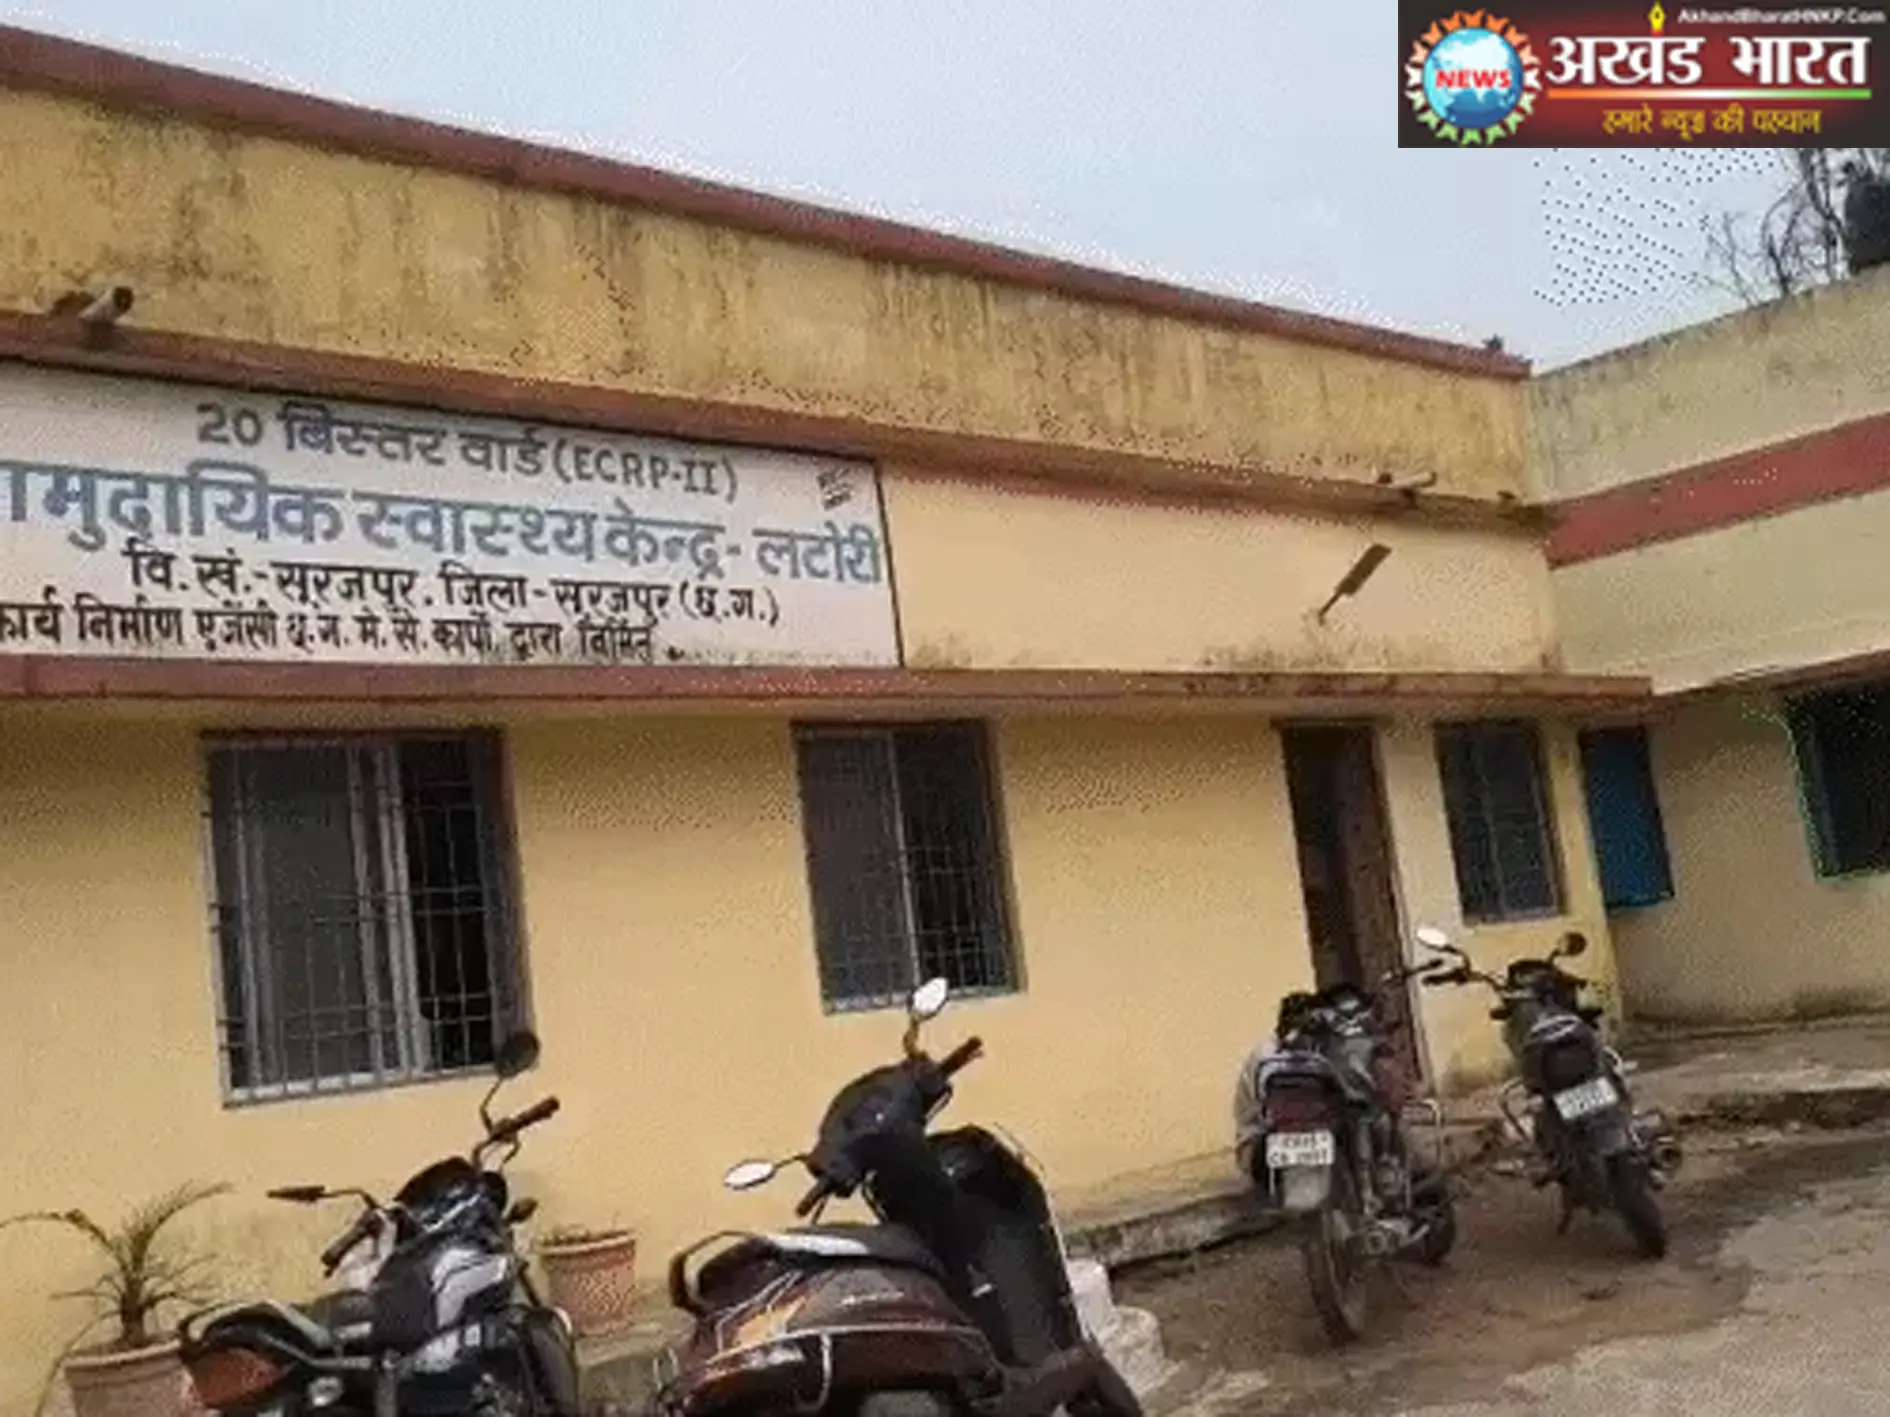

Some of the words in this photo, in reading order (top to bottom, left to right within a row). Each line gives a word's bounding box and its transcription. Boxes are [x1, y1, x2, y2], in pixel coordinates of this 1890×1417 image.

[196, 402, 264, 447] 20
[274, 400, 447, 466] बिस्तर
[752, 520, 883, 584] लटोरी
[74, 592, 184, 646] निर्माण
